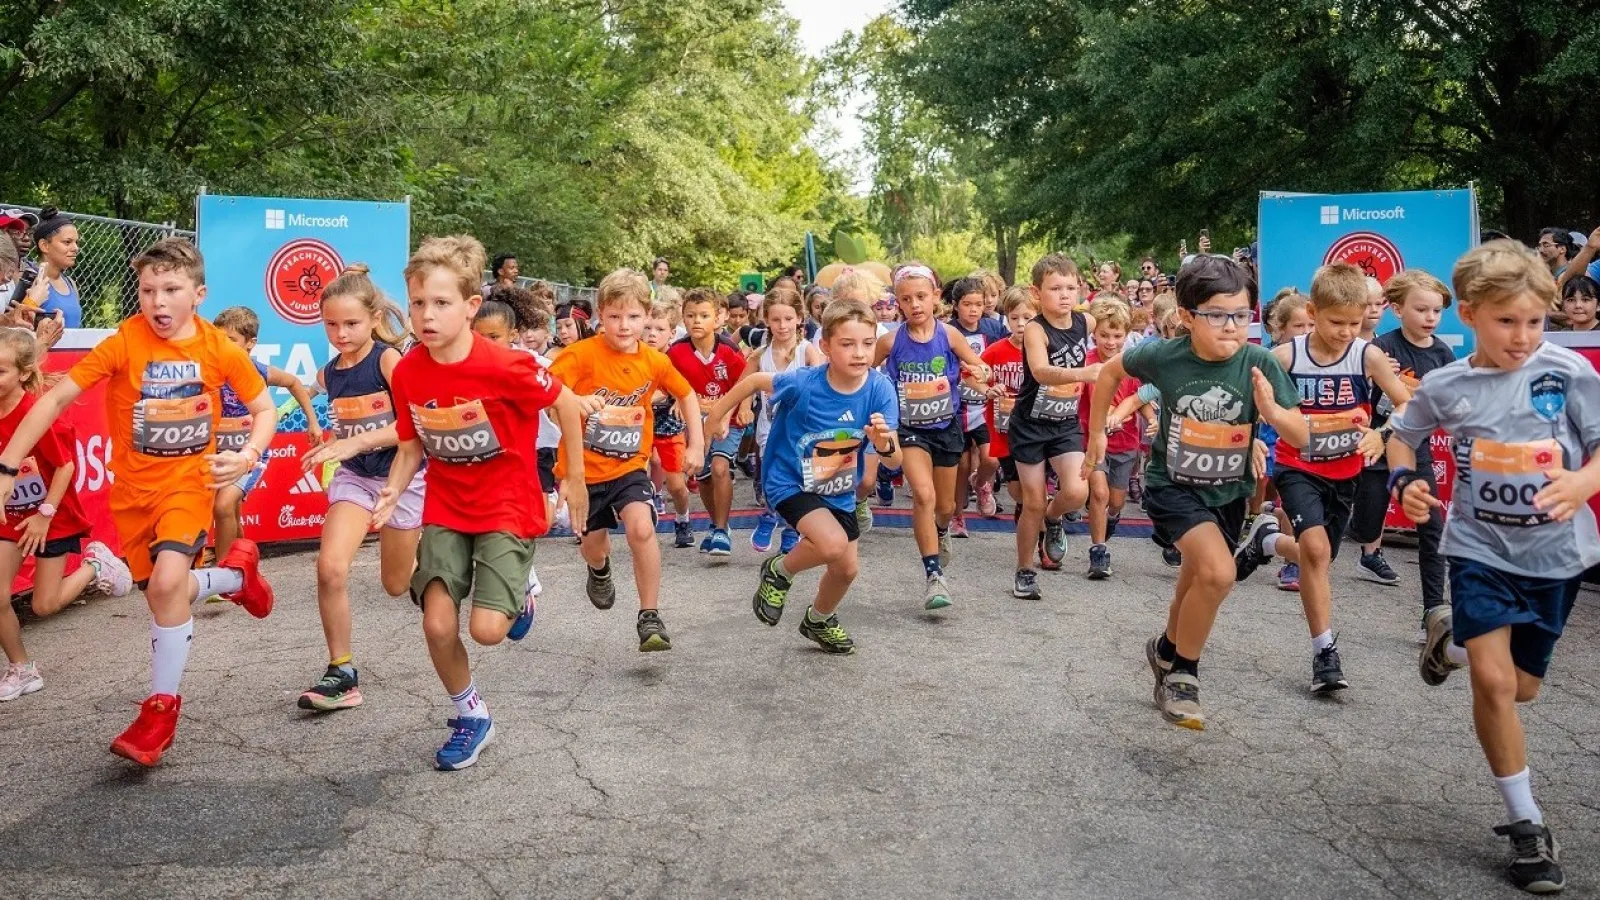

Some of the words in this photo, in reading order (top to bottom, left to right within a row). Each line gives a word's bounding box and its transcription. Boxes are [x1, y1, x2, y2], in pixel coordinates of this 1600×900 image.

[288, 213, 349, 228] Microsoft
[1343, 206, 1405, 220] Microsoft
[283, 252, 332, 271] PEACHTREE
[290, 300, 321, 311] JUNIO
[1296, 377, 1356, 406] USA
[910, 398, 950, 416] 7097
[1044, 399, 1077, 413] 7094
[148, 422, 208, 444] 7024
[430, 430, 490, 452] 7009
[597, 430, 640, 447] 7049
[1167, 414, 1182, 453] MILE
[1314, 431, 1363, 451] 7089
[1180, 450, 1243, 472] 7019
[802, 459, 814, 492] MILE
[817, 474, 853, 495] 7035
[1479, 480, 1552, 506] 600
